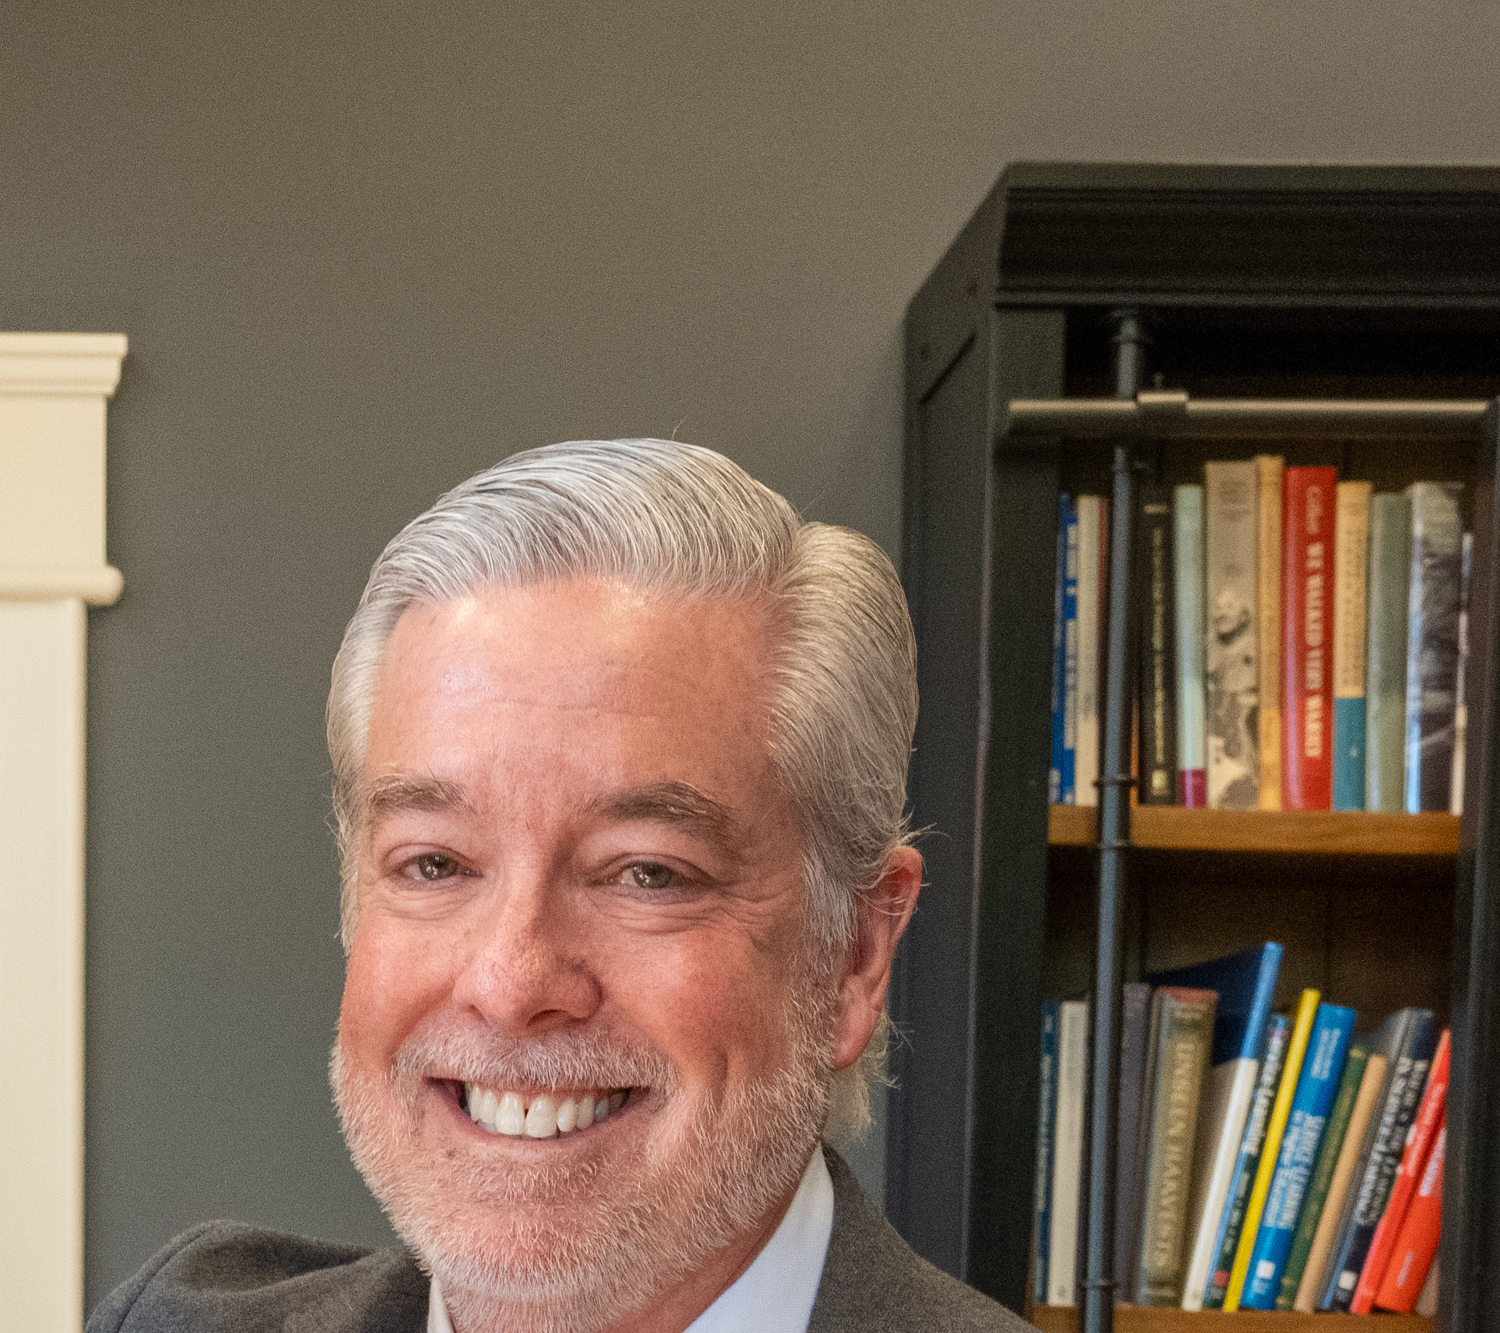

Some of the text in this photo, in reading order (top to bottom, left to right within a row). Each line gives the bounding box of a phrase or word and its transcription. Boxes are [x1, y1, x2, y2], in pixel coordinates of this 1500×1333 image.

[1306, 541, 1323, 568] WE
[1305, 573, 1324, 645] WALKED
[1305, 649, 1323, 690] VERY
[1154, 1041, 1194, 1269] UNSEEN HARVESTS
